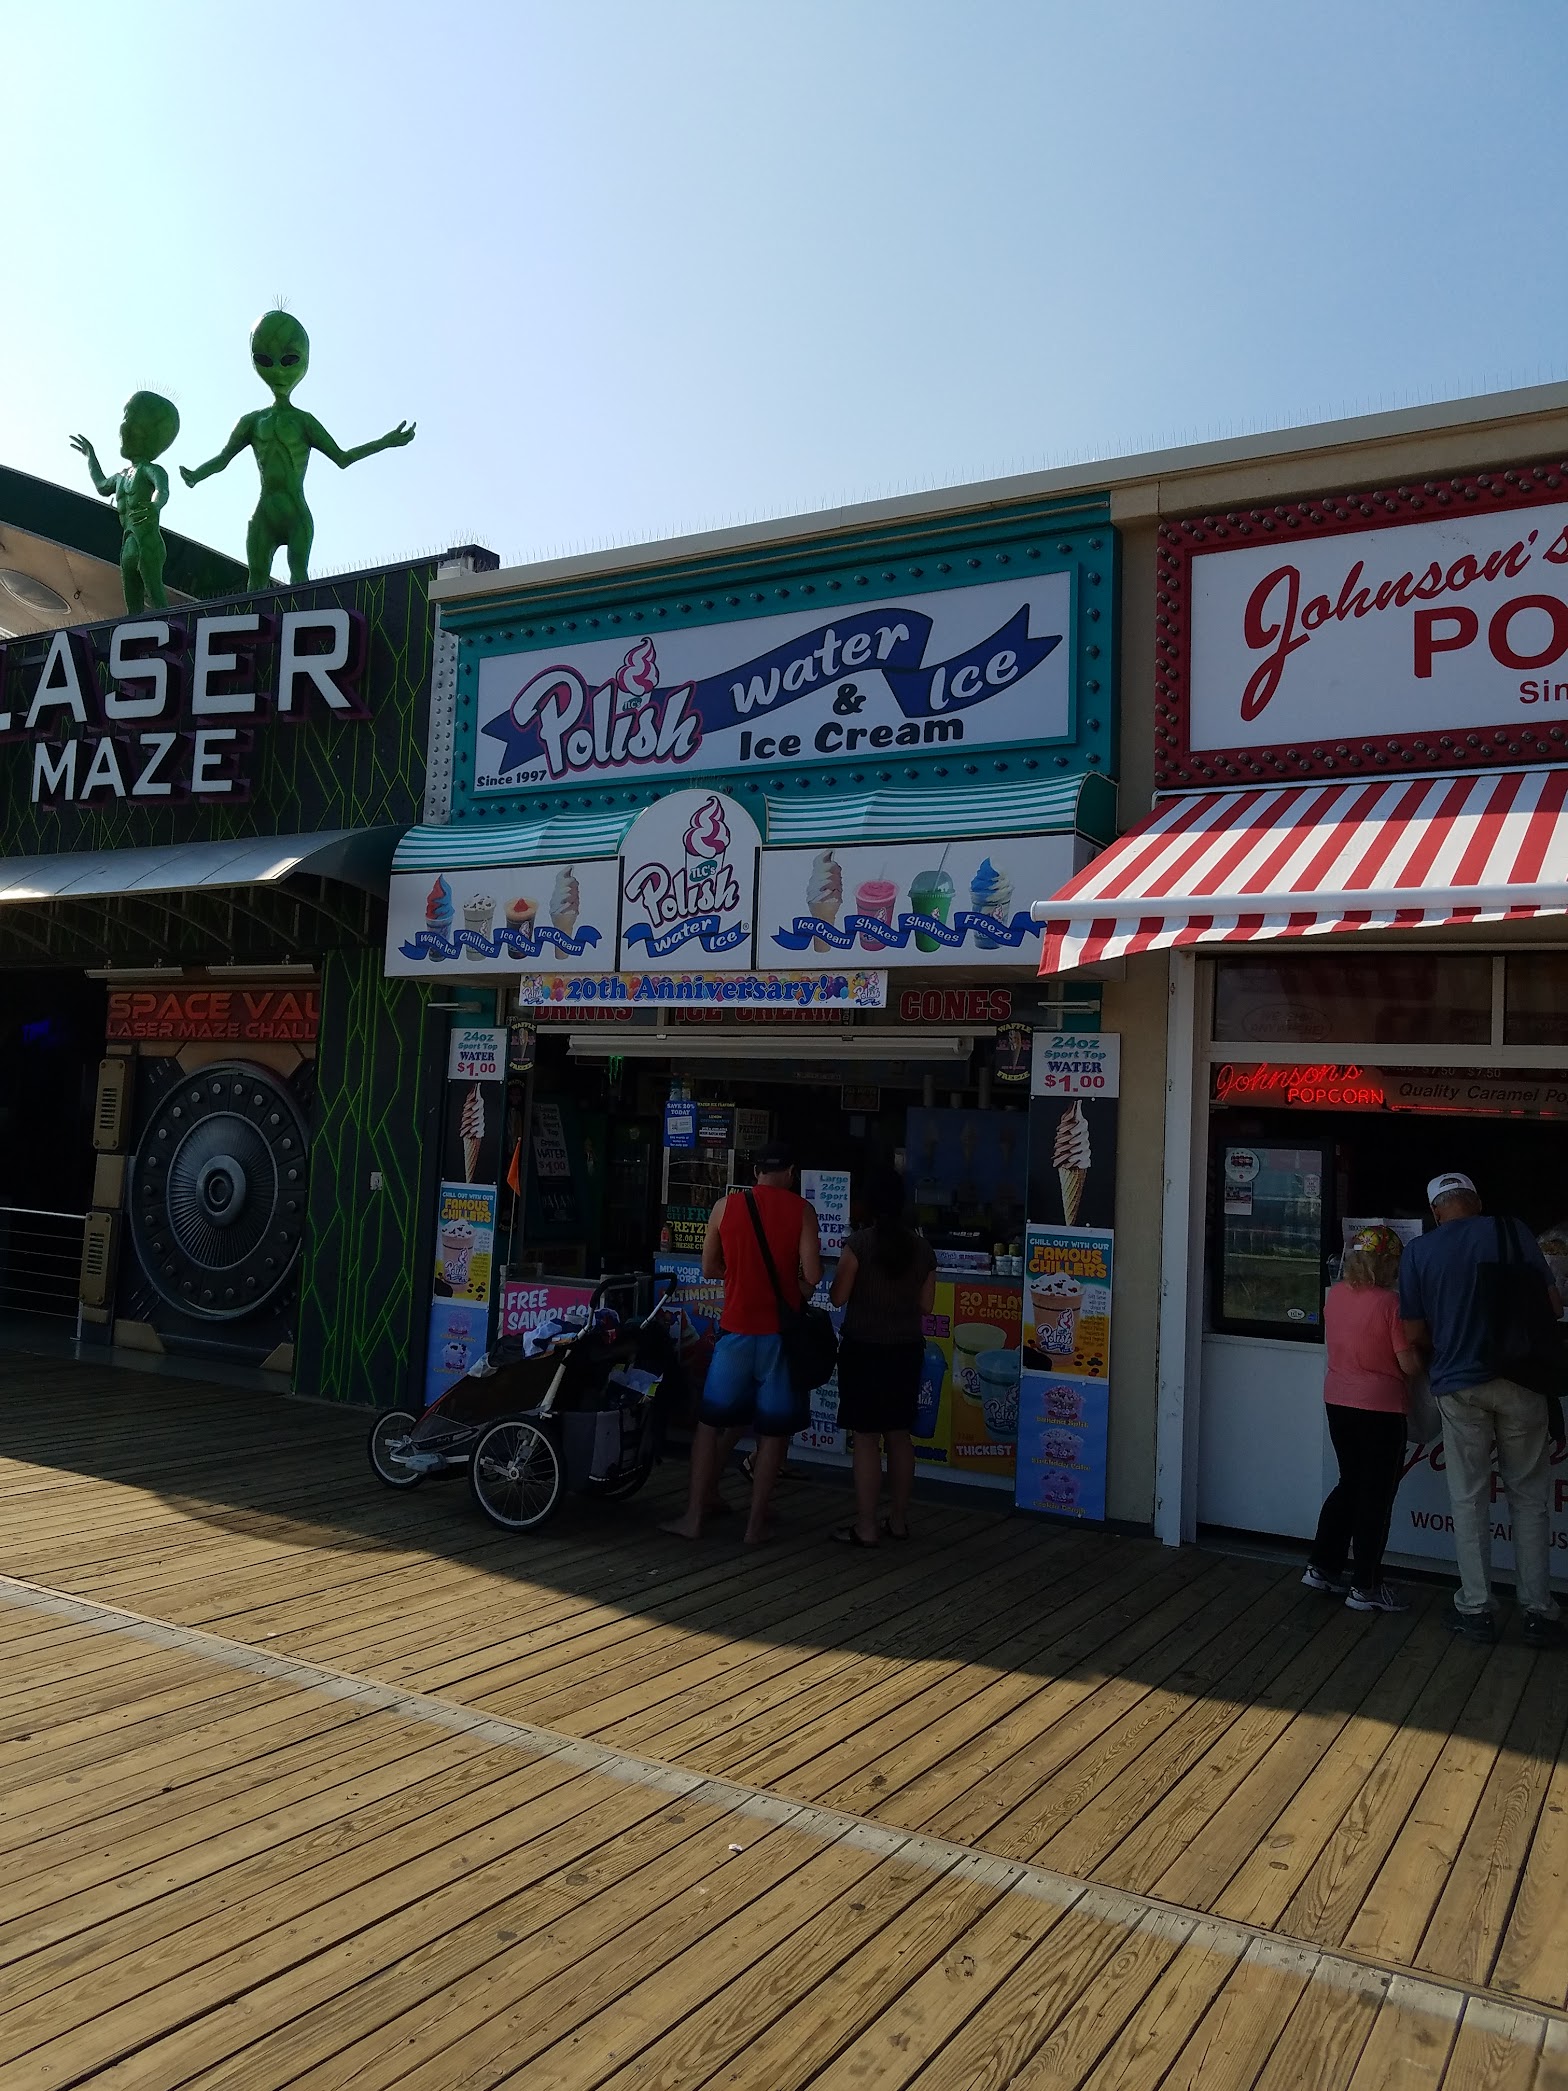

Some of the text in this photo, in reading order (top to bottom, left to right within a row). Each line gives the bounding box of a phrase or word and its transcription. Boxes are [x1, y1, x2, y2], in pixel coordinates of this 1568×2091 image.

[0, 608, 352, 730] ASER
[832, 683, 867, 717] &
[511, 664, 703, 780] Polish
[930, 648, 1019, 712] Ice
[739, 717, 965, 762] Ice Cream
[31, 728, 237, 803] MAZE
[476, 769, 548, 788] Since 1997
[690, 864, 717, 880] TLC's
[625, 862, 740, 928] Polish
[797, 918, 851, 946] Ice Cream
[854, 917, 898, 943] Shakes
[904, 915, 960, 943] Slushees
[963, 913, 1013, 941] Freeze
[419, 933, 457, 957] Water Ice
[458, 931, 495, 955] Chillers
[500, 930, 536, 955] Ice Caps
[538, 928, 582, 953] Ice Cream
[709, 930, 738, 951] Ice
[565, 974, 829, 1006] 20th Anniversary!
[109, 991, 234, 1021] SPACE
[900, 989, 1012, 1021] CONES
[107, 1022, 317, 1039] LASER MAZE CHALL
[464, 1031, 494, 1042] 24oz
[997, 1022, 1032, 1034] WAFFLE
[458, 1042, 498, 1051] Sport Top
[1051, 1036, 1100, 1049] 24oz
[460, 1051, 495, 1061] WATER
[1044, 1050, 1106, 1061] Sport Top
[457, 1062, 496, 1077] $1.00
[996, 1070, 1031, 1082] FREEZE
[1048, 1061, 1102, 1074] WATER
[1044, 1074, 1105, 1092] $1.00
[1287, 1088, 1385, 1105] POPCORN
[1399, 1082, 1568, 1104] Quality Caramel Po
[819, 1174, 849, 1183] Large
[822, 1183, 846, 1191] 24oz
[819, 1191, 849, 1201] Sport
[444, 1198, 489, 1212] FAMOUS
[824, 1200, 843, 1210] Top
[441, 1207, 491, 1223] CHILLERS
[674, 1234, 694, 1243] $2.00
[1029, 1238, 1109, 1251] CHILL OUT WITH OUR
[1033, 1245, 1103, 1265] FAMOUS
[660, 1265, 701, 1275] MIX YOUR
[1028, 1258, 1107, 1279] CHILLERS
[507, 1288, 550, 1311] FREE
[960, 1291, 983, 1307] 20
[959, 1306, 975, 1317] TO
[1036, 1323, 1072, 1345] Polish
[820, 1398, 837, 1410] Top
[800, 1431, 834, 1447] $1.00
[956, 1444, 1012, 1456] THICKEST
